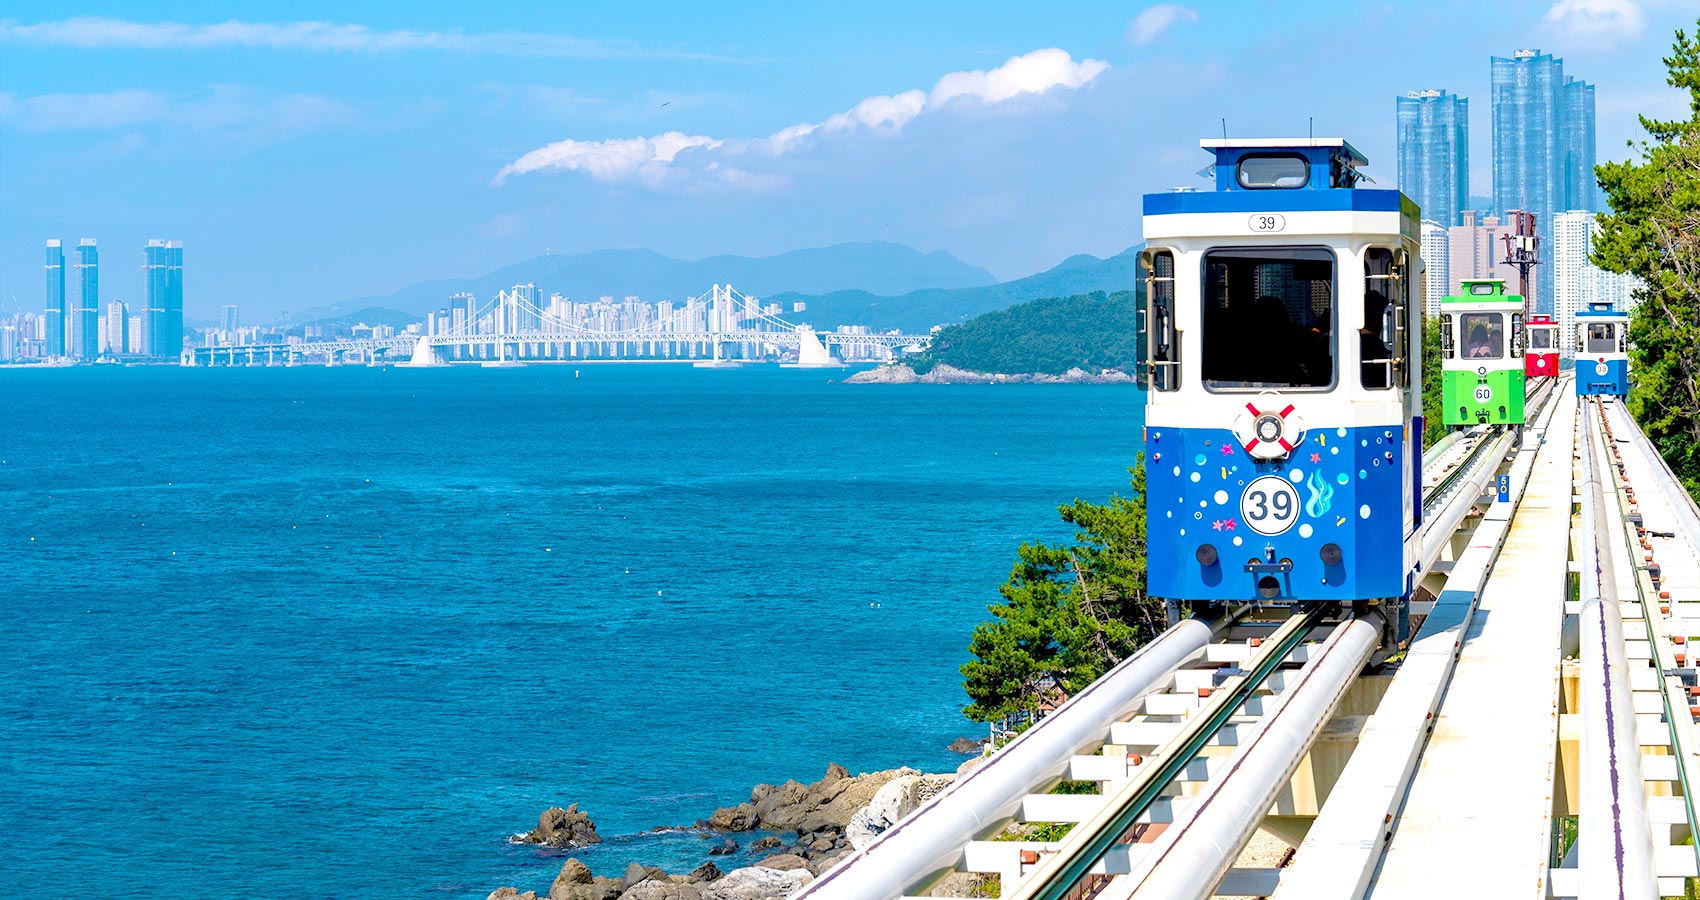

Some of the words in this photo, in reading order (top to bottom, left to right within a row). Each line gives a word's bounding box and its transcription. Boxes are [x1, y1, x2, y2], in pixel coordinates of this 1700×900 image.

[1259, 216, 1275, 230] 39
[1597, 365, 1607, 373] 38
[1475, 388, 1490, 399] 60
[1500, 476, 1507, 494] 50
[1249, 490, 1292, 520] 39
